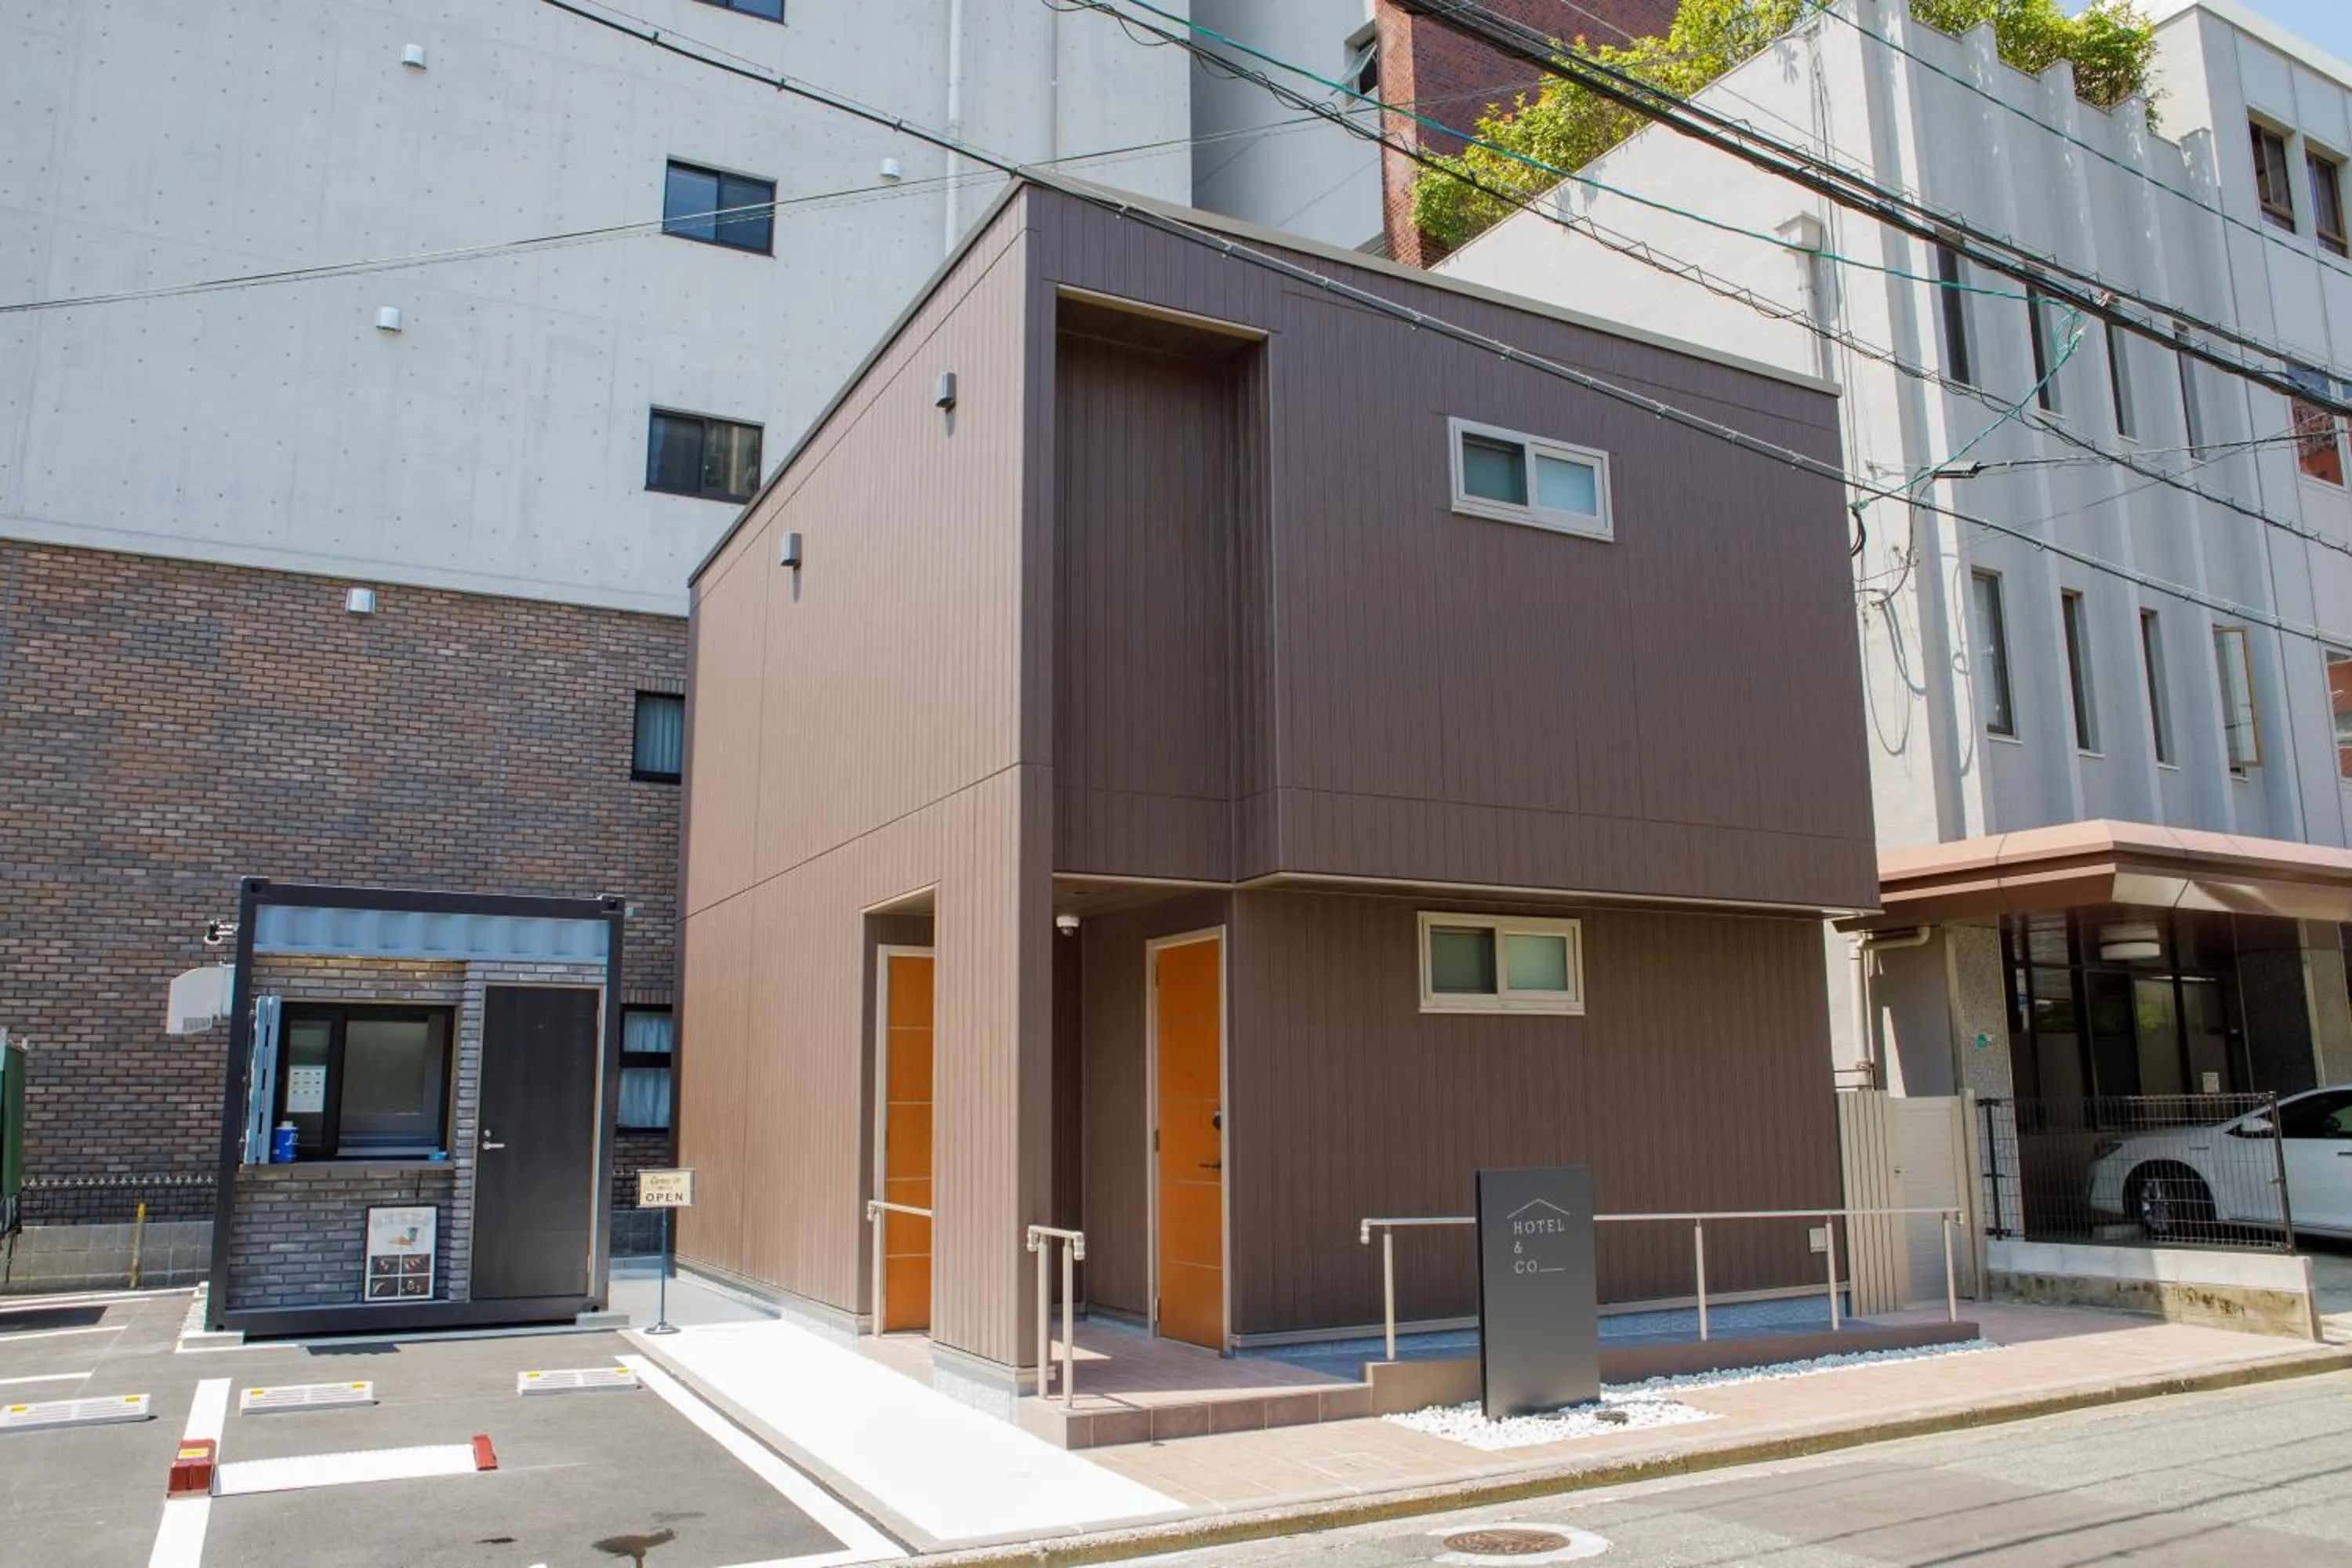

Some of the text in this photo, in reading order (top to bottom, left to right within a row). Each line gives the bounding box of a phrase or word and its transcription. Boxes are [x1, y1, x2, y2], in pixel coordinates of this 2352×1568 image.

[645, 1192, 683, 1202] OPEN
[1513, 1218, 1565, 1235] HOTEL
[1514, 1241, 1523, 1254] &
